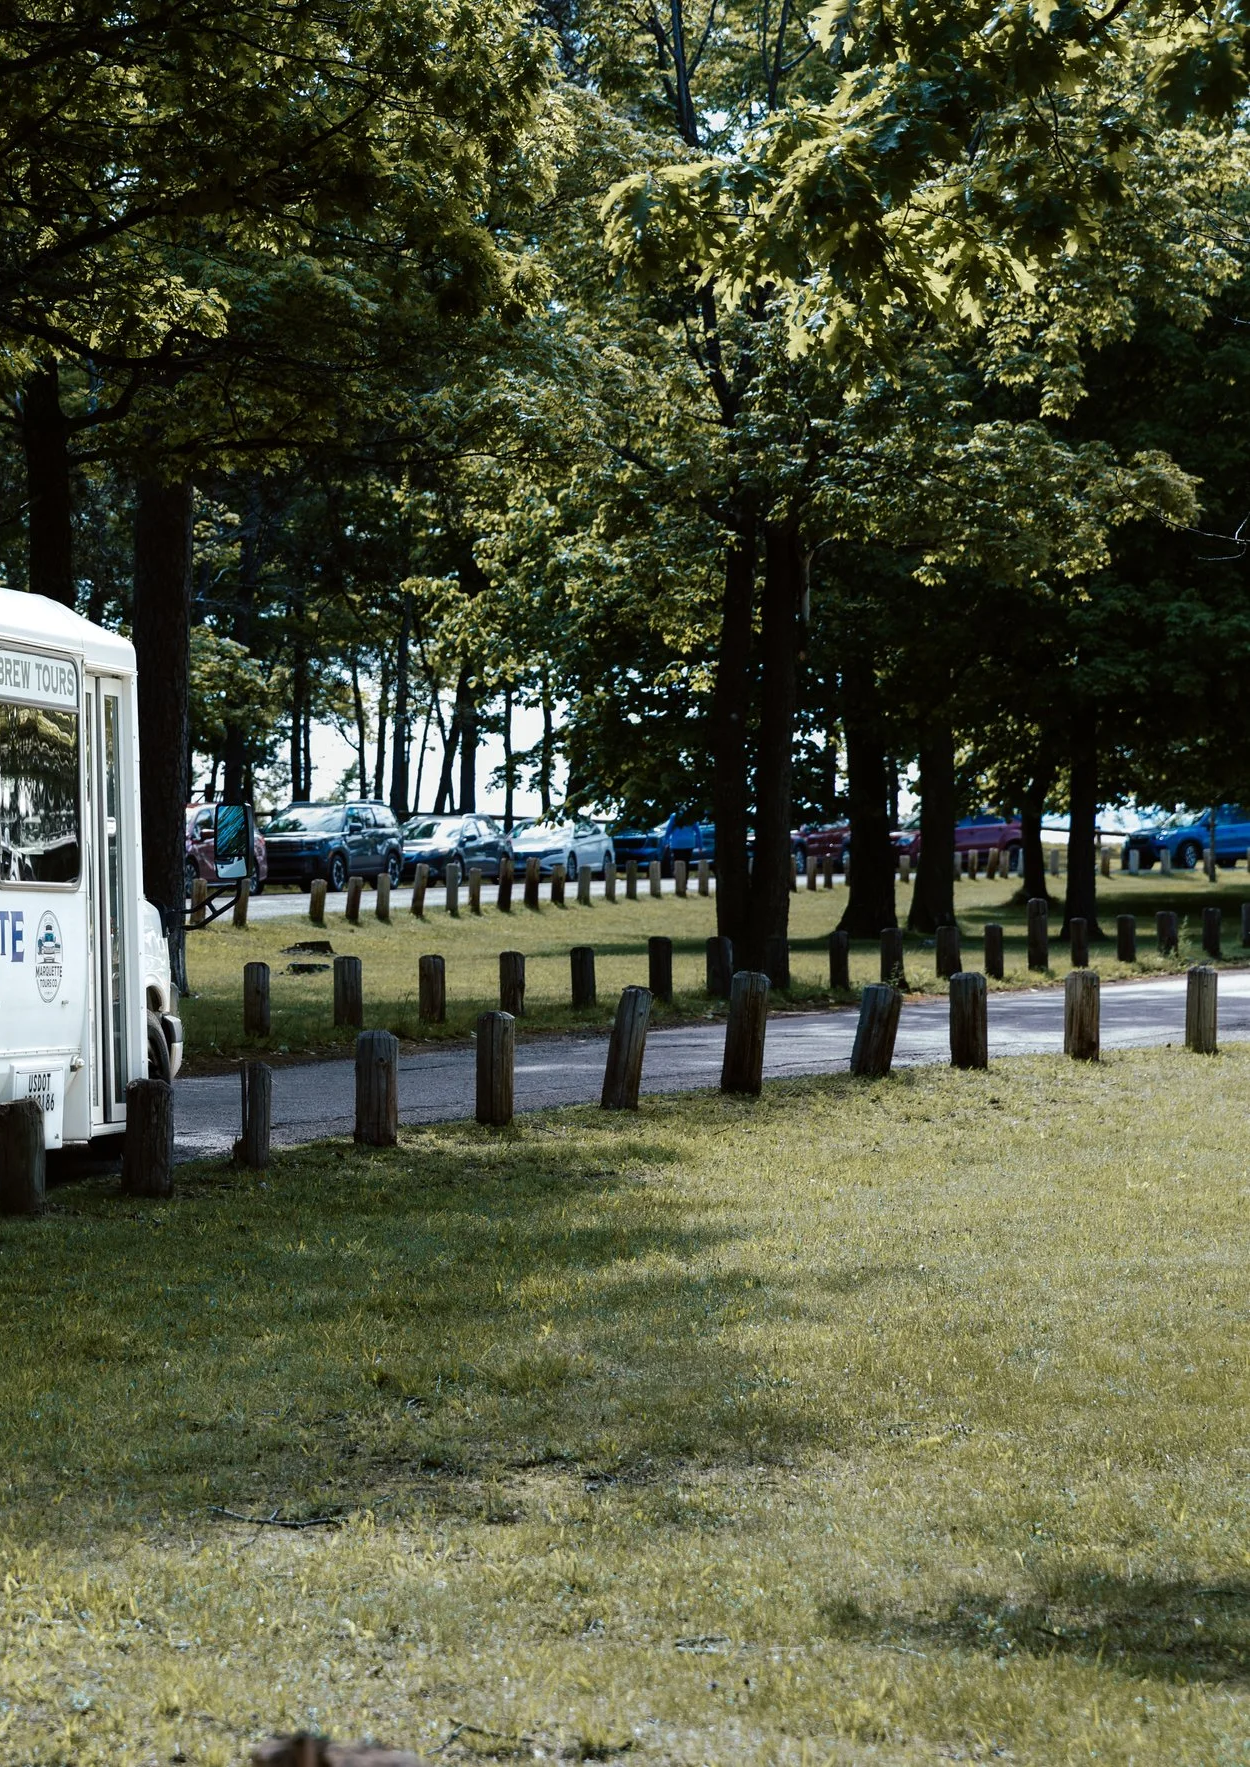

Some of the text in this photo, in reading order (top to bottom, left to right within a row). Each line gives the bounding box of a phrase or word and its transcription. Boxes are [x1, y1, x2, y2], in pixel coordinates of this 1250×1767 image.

[35, 663, 74, 696] TOURS
[35, 966, 62, 977] MARQUETTE
[29, 1073, 51, 1092] USDOT
